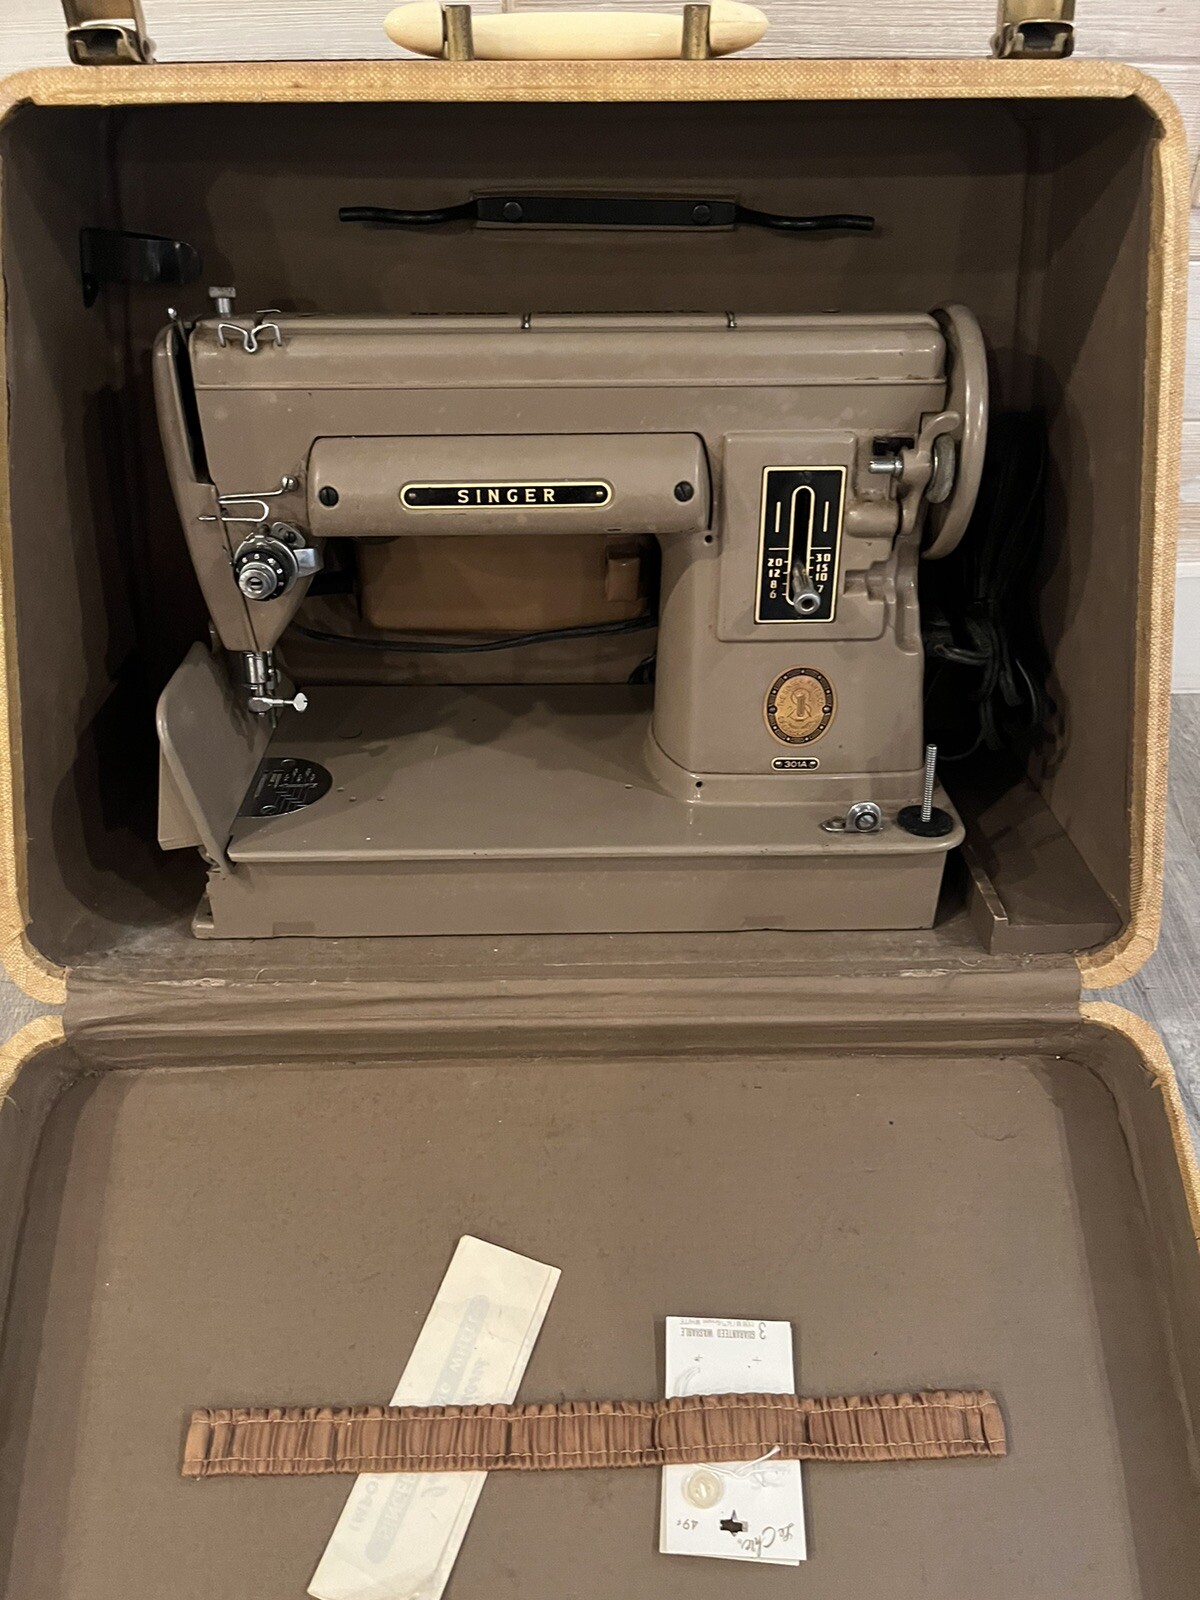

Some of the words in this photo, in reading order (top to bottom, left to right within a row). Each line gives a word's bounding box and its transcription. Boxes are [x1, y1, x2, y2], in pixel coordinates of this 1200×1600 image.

[457, 488, 555, 503] SINGER
[767, 557, 783, 567] 20
[815, 553, 831, 562] 30
[816, 563, 828, 572] 15
[768, 569, 781, 578] 12
[815, 573, 828, 581] 10
[769, 579, 777, 589] 8
[817, 585, 824, 593] 7
[769, 590, 777, 599] 6
[783, 760, 807, 768] 301A
[758, 1321, 767, 1340] 3
